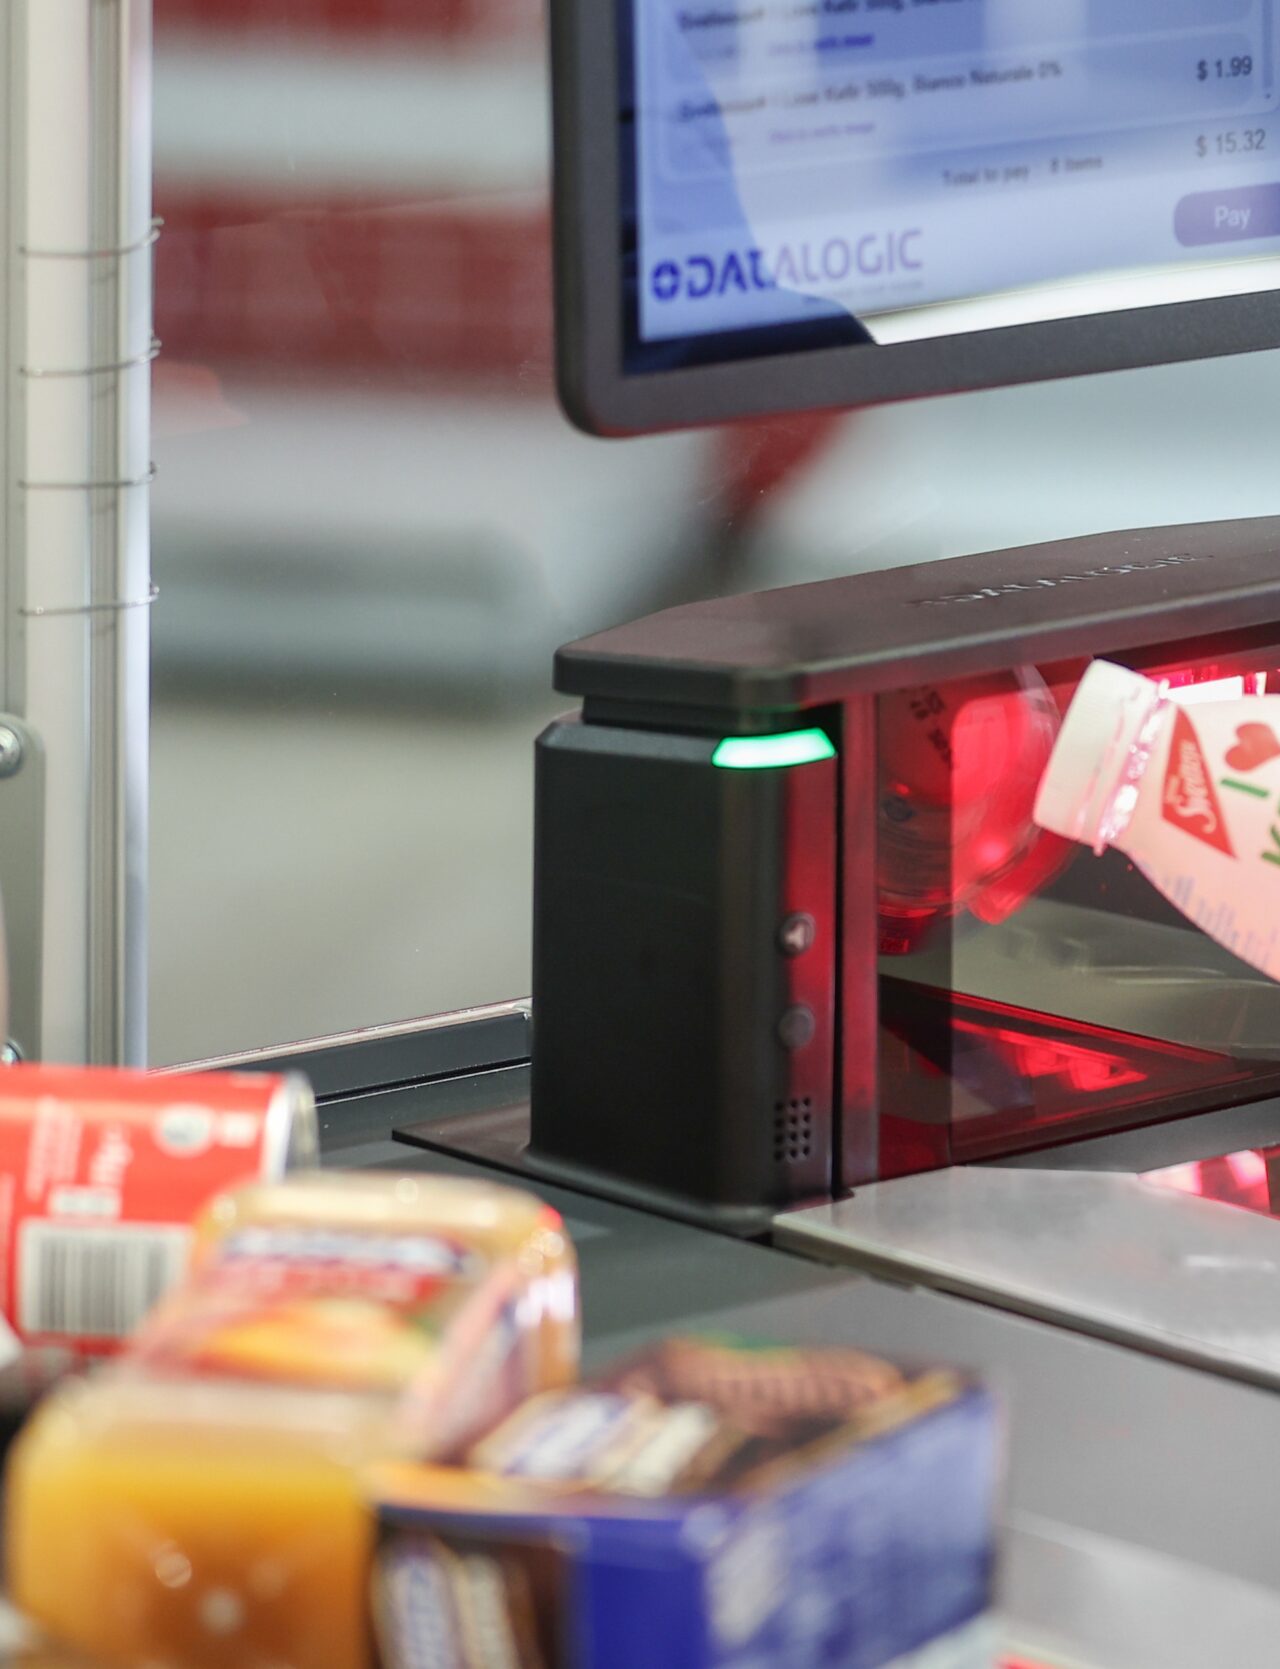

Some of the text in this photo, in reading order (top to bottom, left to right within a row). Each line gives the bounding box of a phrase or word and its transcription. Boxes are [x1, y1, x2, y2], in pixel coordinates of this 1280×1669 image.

[1197, 55, 1253, 81] $ 1.99
[1196, 128, 1267, 157] $ 15.32
[1214, 205, 1251, 230] Pay
[686, 228, 922, 298] DATALOGIC
[1220, 777, 1270, 799] I
